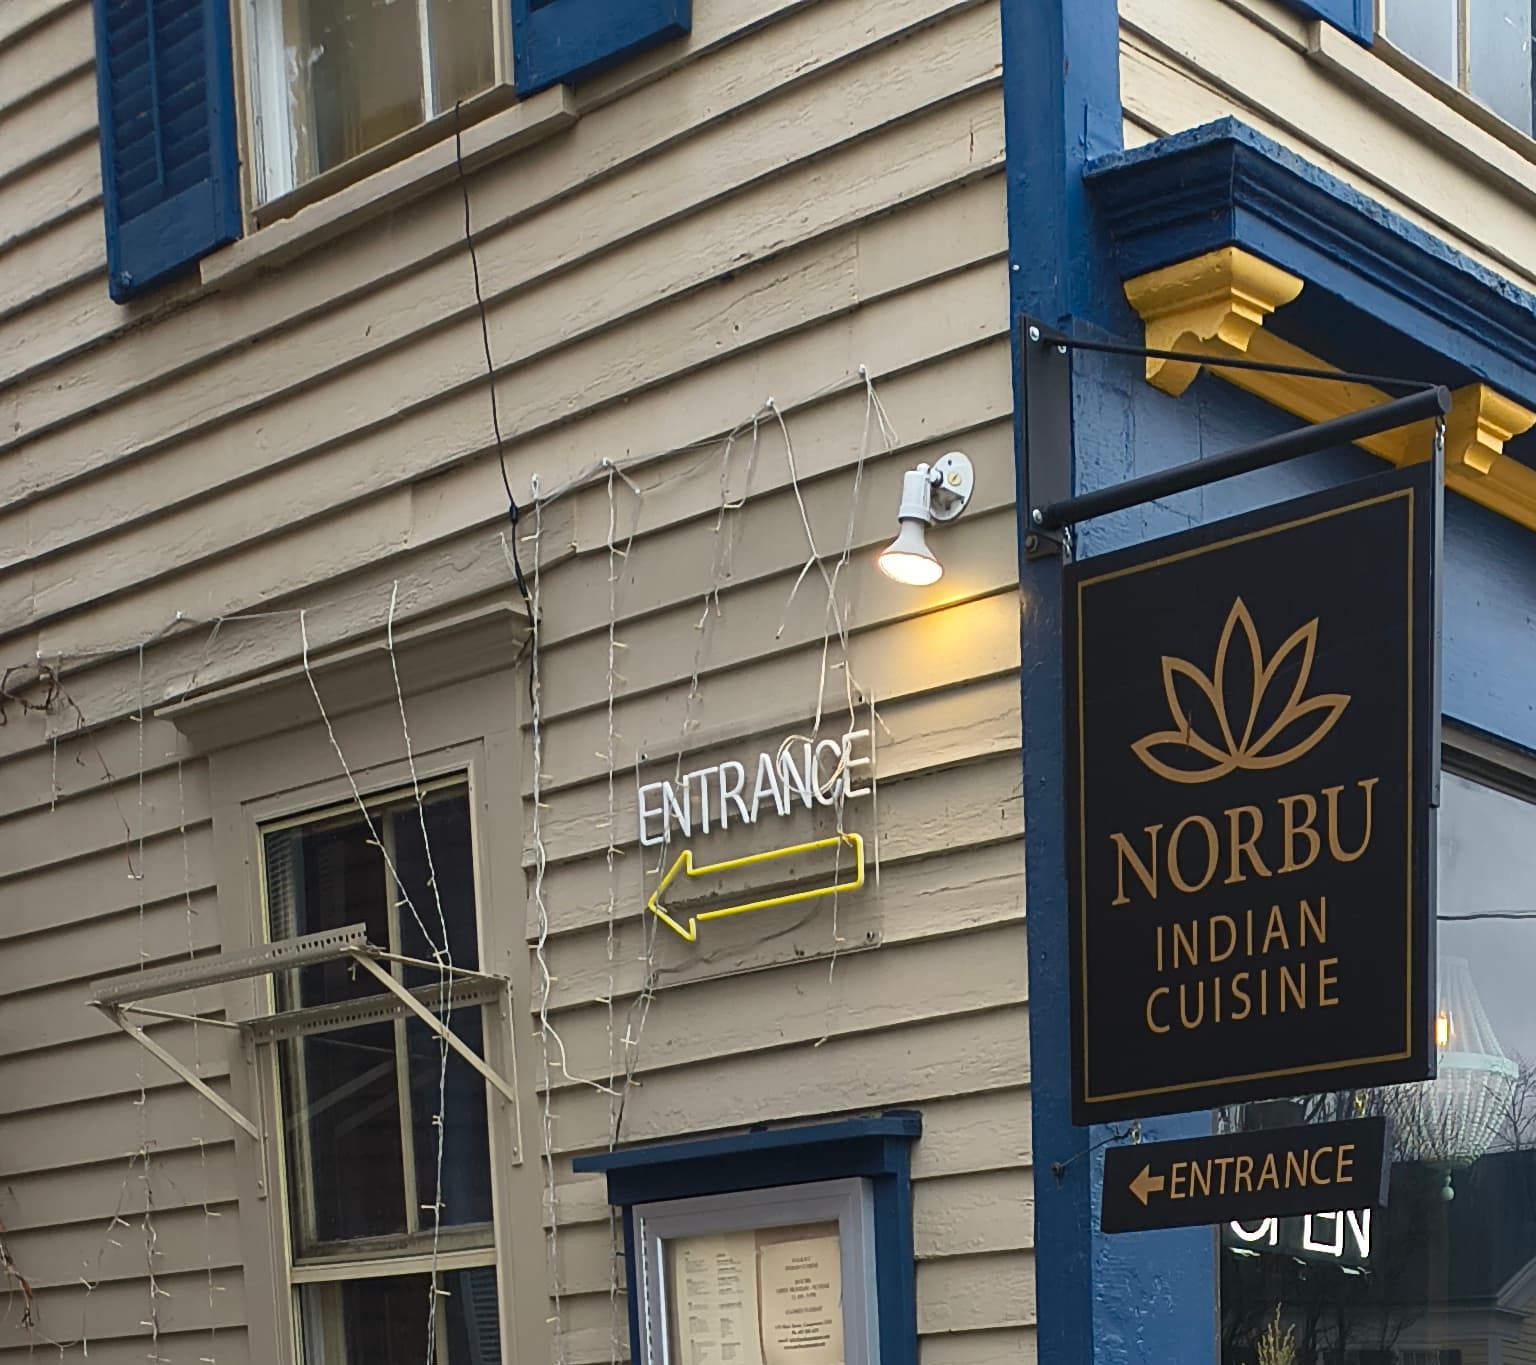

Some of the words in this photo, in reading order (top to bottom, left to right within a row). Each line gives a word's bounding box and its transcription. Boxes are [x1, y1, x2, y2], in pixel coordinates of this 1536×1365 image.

[638, 728, 871, 847] ENTRANCE
[1109, 776, 1380, 906] NORBU
[1155, 896, 1327, 972] INDIAN
[1146, 957, 1340, 1033] CUISINE
[1169, 1144, 1356, 1201] ENTRANCE
